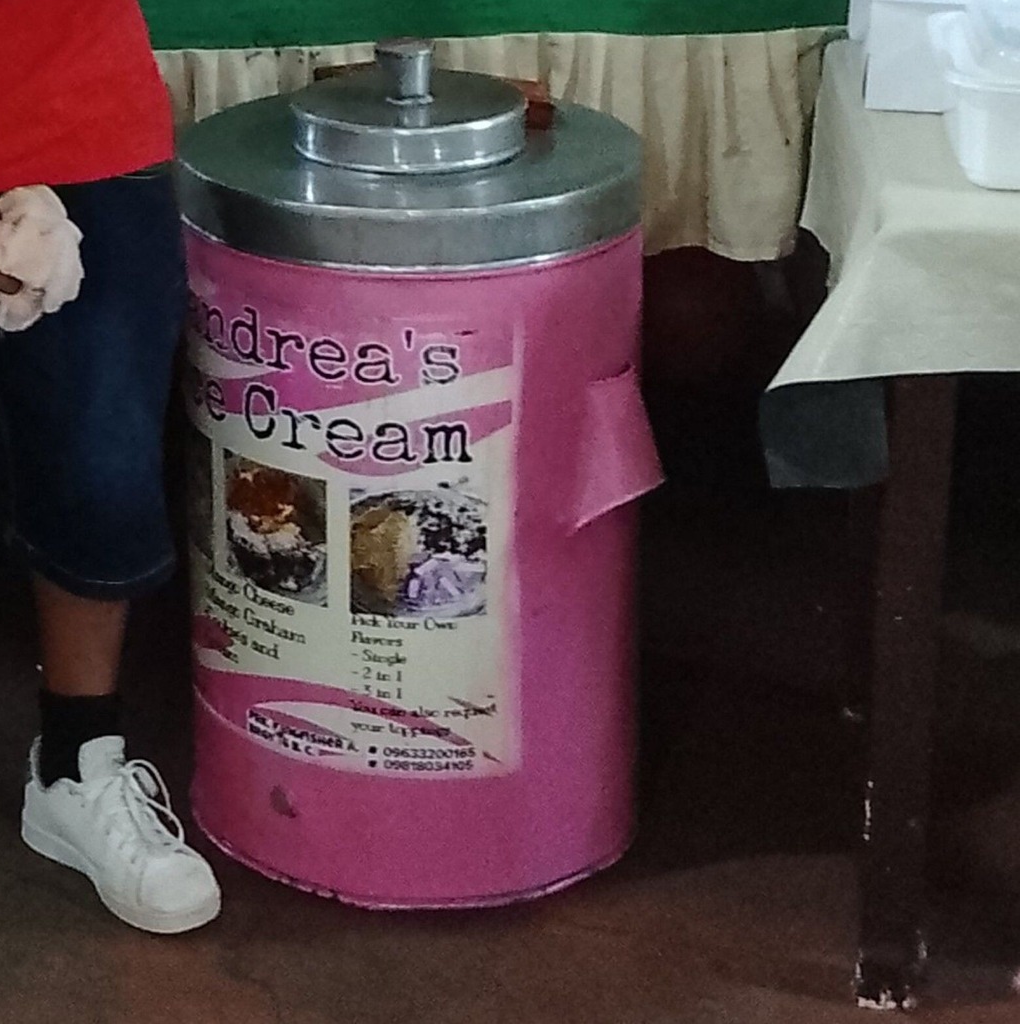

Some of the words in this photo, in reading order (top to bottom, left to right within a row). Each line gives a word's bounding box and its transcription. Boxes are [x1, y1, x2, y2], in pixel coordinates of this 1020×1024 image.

[191, 298, 459, 385] ndrea's
[244, 383, 473, 464] Cream
[243, 607, 306, 644] Graham
[351, 631, 403, 647] Flavors
[362, 649, 407, 667] Single
[363, 666, 371, 680] 2
[411, 706, 440, 718] also
